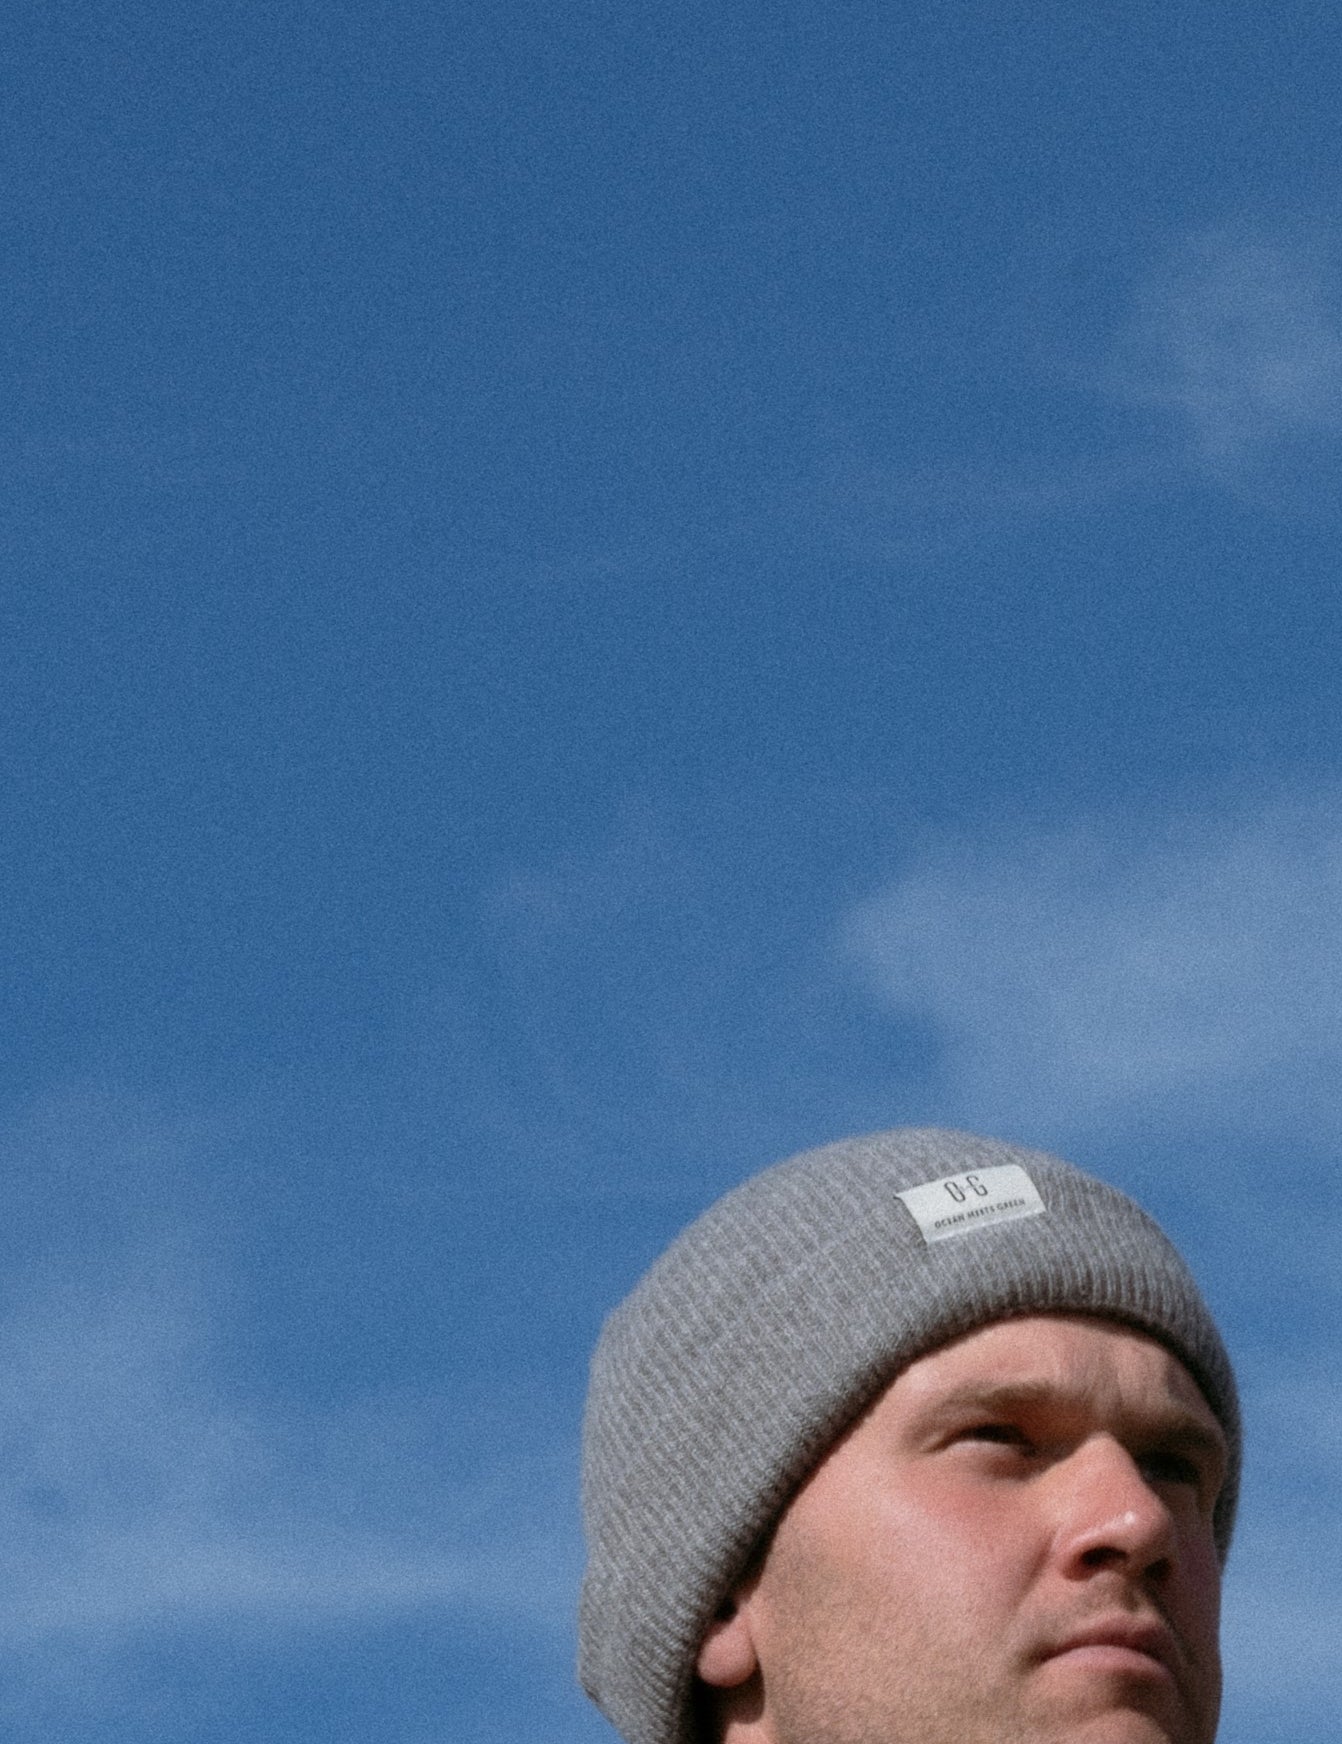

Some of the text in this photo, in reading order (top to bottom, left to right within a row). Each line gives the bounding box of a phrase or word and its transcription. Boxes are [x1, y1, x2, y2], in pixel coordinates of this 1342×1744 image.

[934, 1198, 1025, 1229] OCEAN MEETS GREEN
